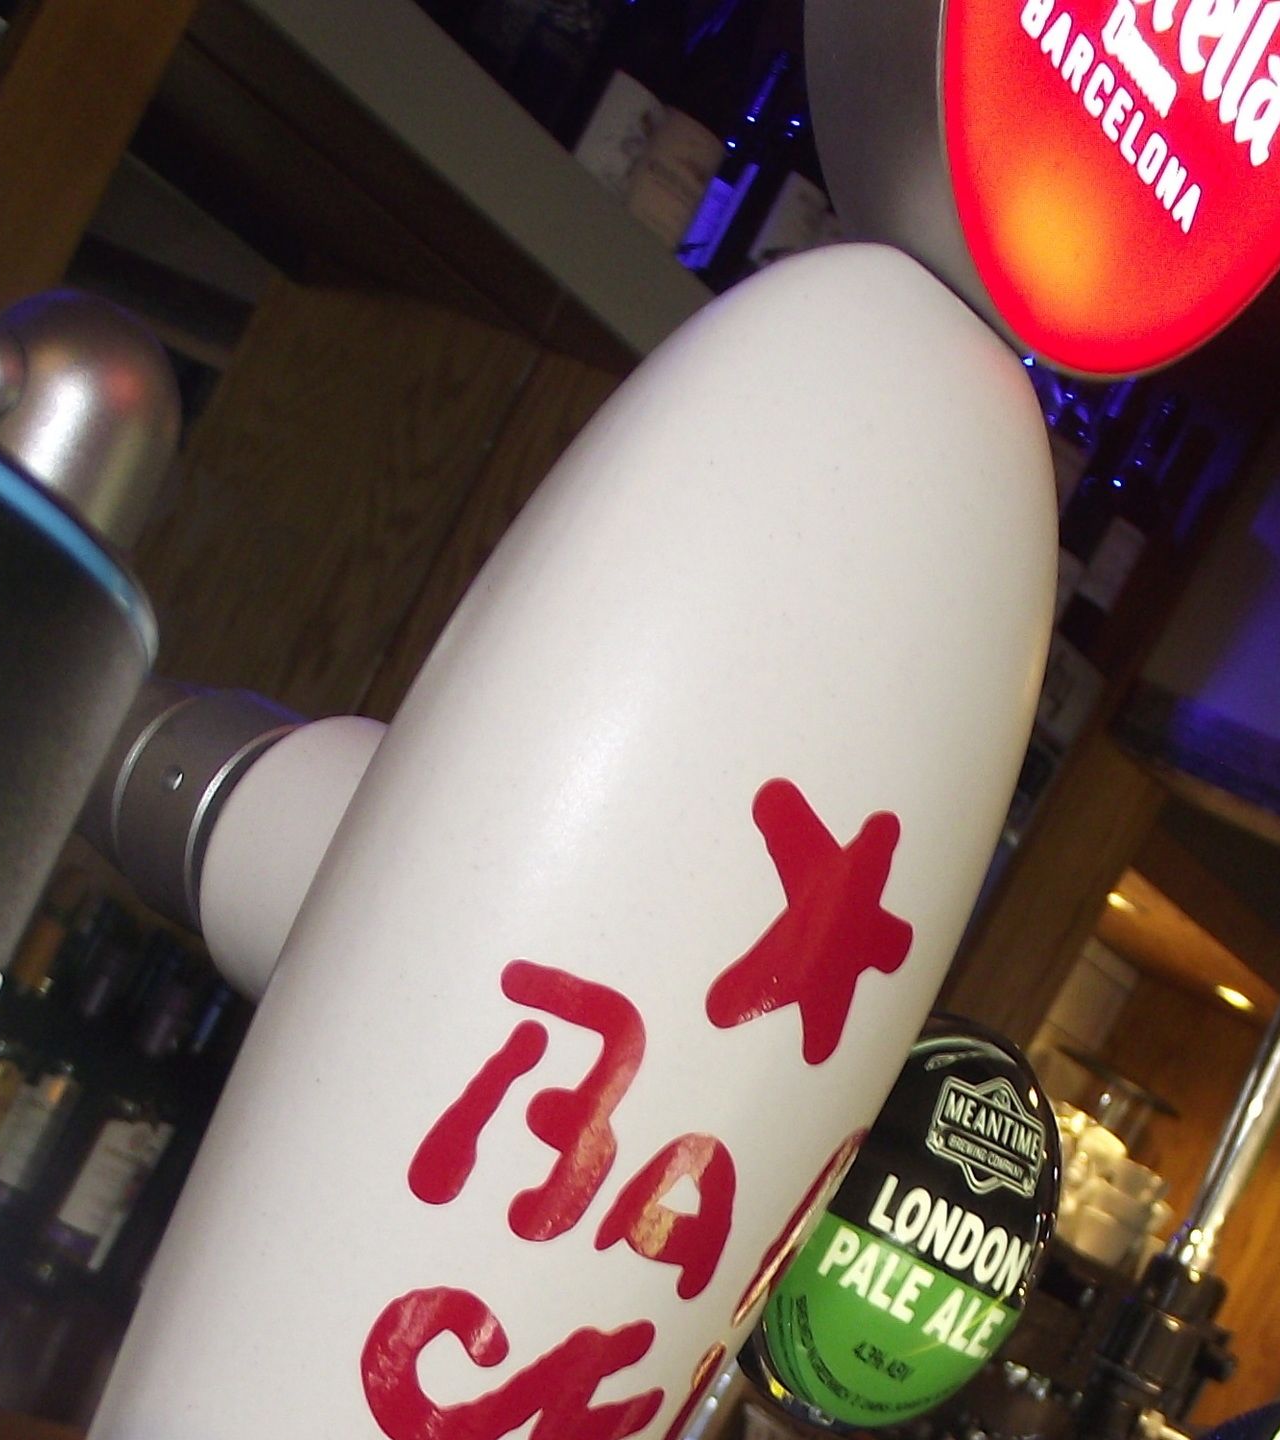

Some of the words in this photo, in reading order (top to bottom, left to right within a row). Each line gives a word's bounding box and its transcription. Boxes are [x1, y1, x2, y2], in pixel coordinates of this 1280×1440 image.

[1020, 0, 1201, 234] BARCELONA
[943, 1089, 1042, 1161] MEANTIME
[818, 1224, 934, 1324] PALE
[922, 1287, 1006, 1358] ALE
[868, 1172, 1031, 1298] LONDON
